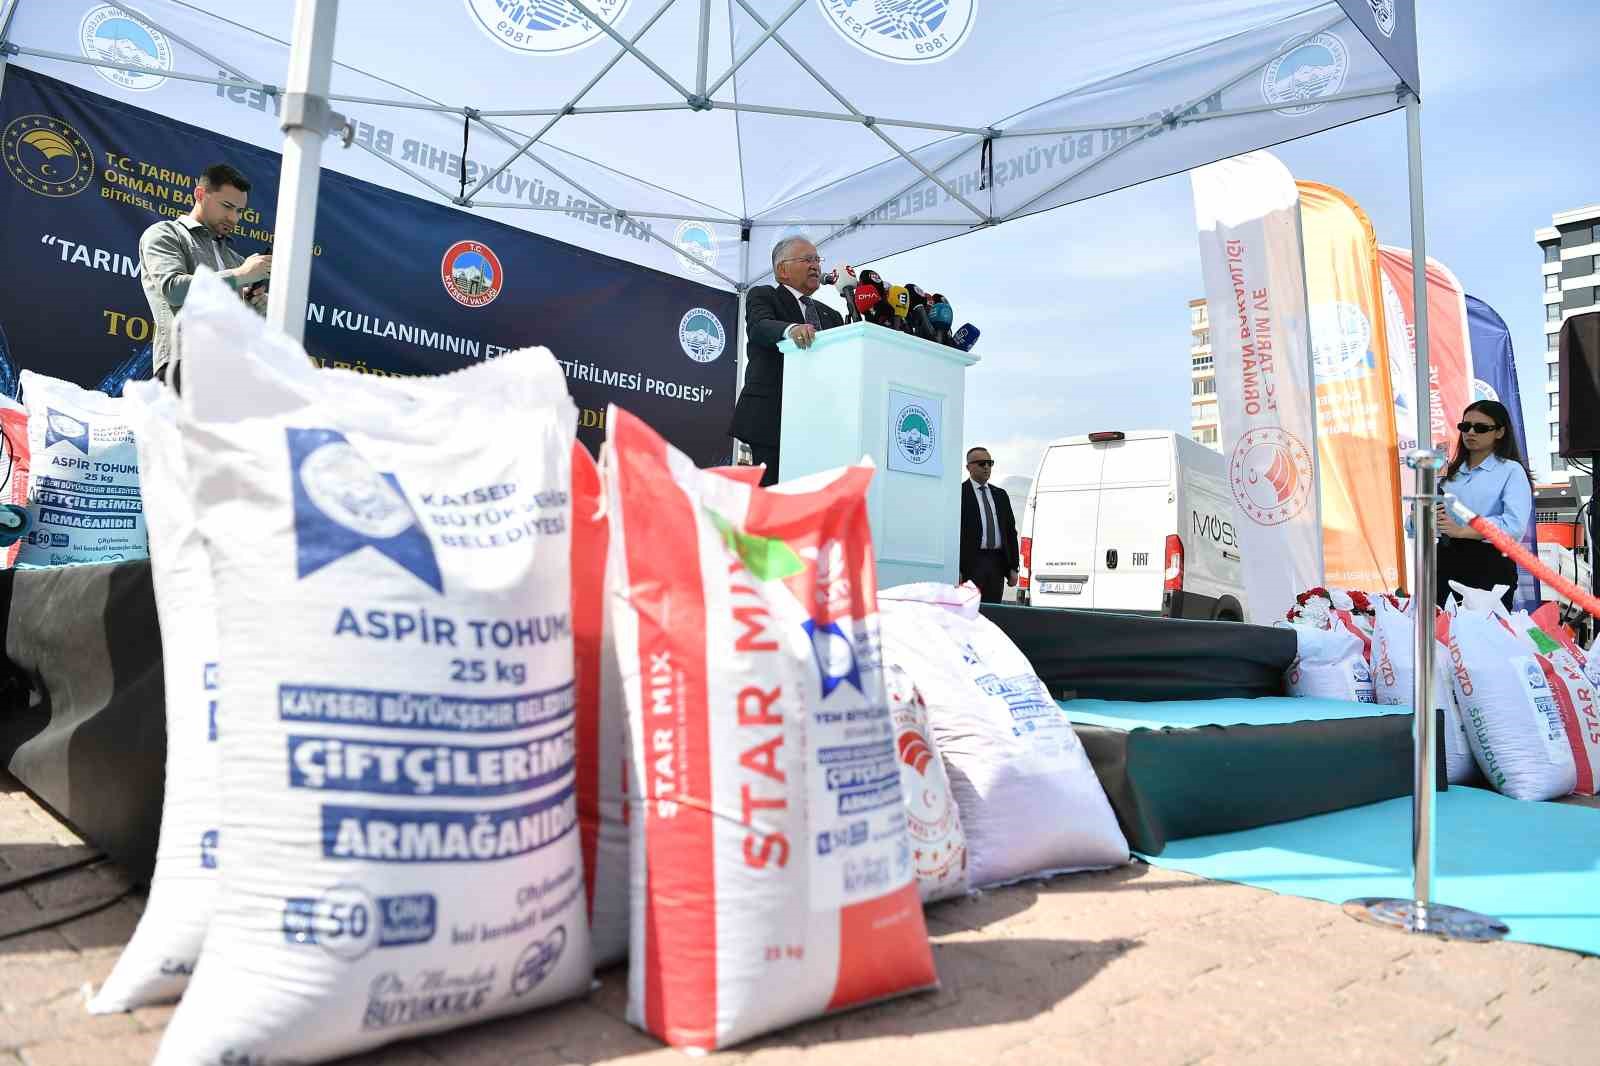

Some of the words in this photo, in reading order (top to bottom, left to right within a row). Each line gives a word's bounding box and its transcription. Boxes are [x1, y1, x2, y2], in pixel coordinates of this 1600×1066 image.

[104, 169, 169, 200] ORMAN
[105, 152, 135, 173] T.C.
[138, 161, 191, 188] TARIM
[101, 187, 156, 213] BİTKİSEL
[331, 307, 480, 358] KULLANIMININ
[51, 456, 90, 470] ASPİR
[84, 473, 98, 481] 25
[101, 473, 114, 483] kg
[42, 511, 135, 529] ARMAĞANIDIR
[39, 534, 50, 544] 50
[1132, 552, 1149, 566] FIAT
[334, 606, 457, 648] ASPİR
[450, 659, 488, 683] 25
[495, 659, 527, 685] kg
[650, 650, 673, 716] MIX
[1577, 687, 1600, 745] STAR
[652, 728, 679, 820] STAR
[736, 684, 791, 870] STAR
